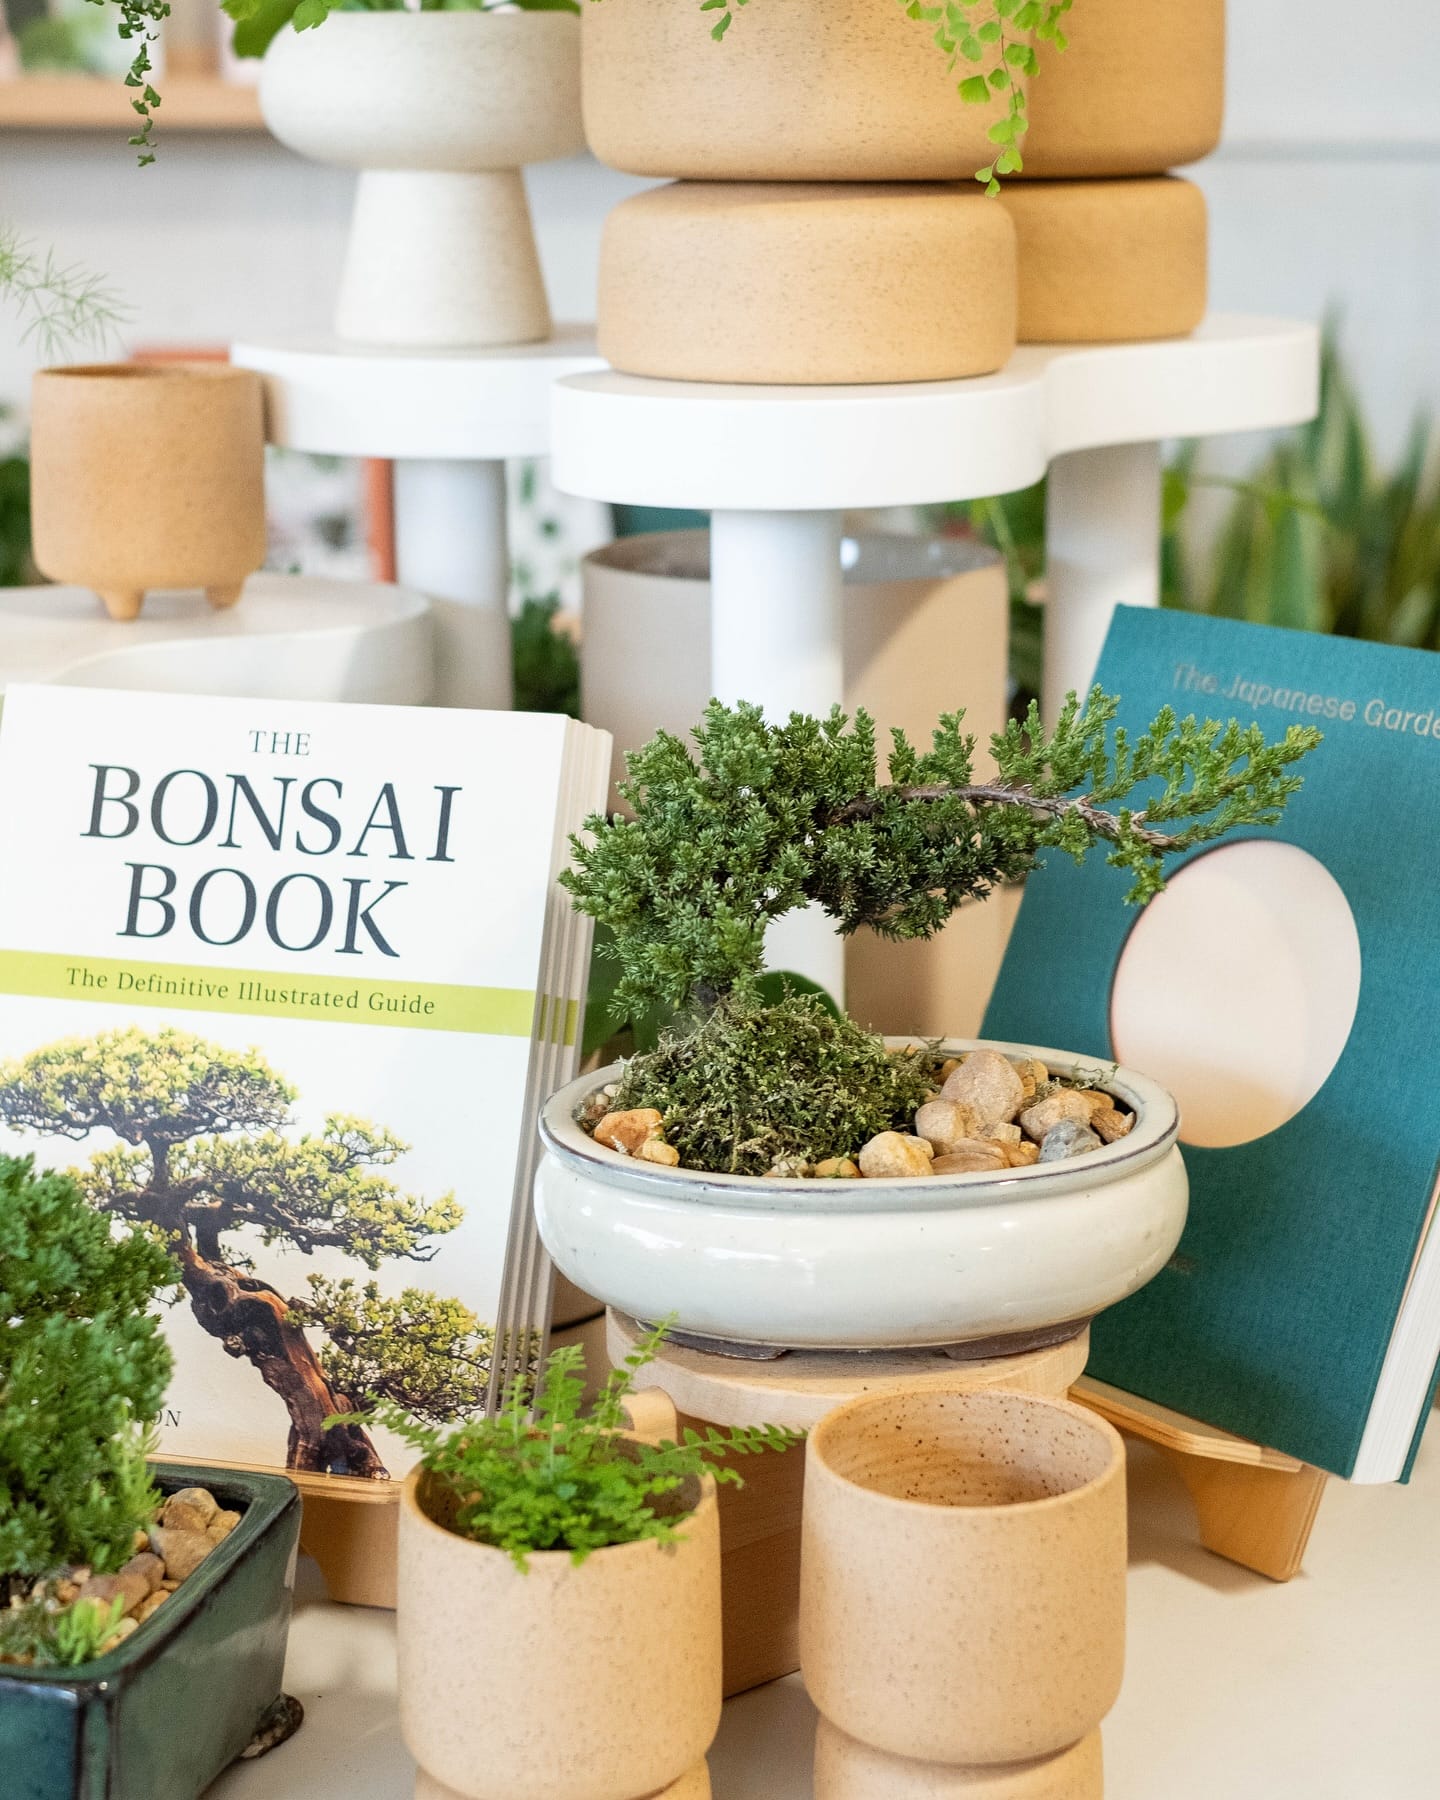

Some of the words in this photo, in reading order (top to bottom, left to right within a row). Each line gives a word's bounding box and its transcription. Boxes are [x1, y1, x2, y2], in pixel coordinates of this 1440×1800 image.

[1173, 662, 1219, 694] The
[1221, 674, 1357, 722] Japanese
[248, 730, 312, 756] THE
[79, 763, 463, 863] BONSAI
[115, 861, 409, 958] BOOK
[66, 967, 108, 989] The
[117, 971, 229, 999] Definitive
[238, 981, 359, 1009] Illustrated
[368, 991, 436, 1015] Guide
